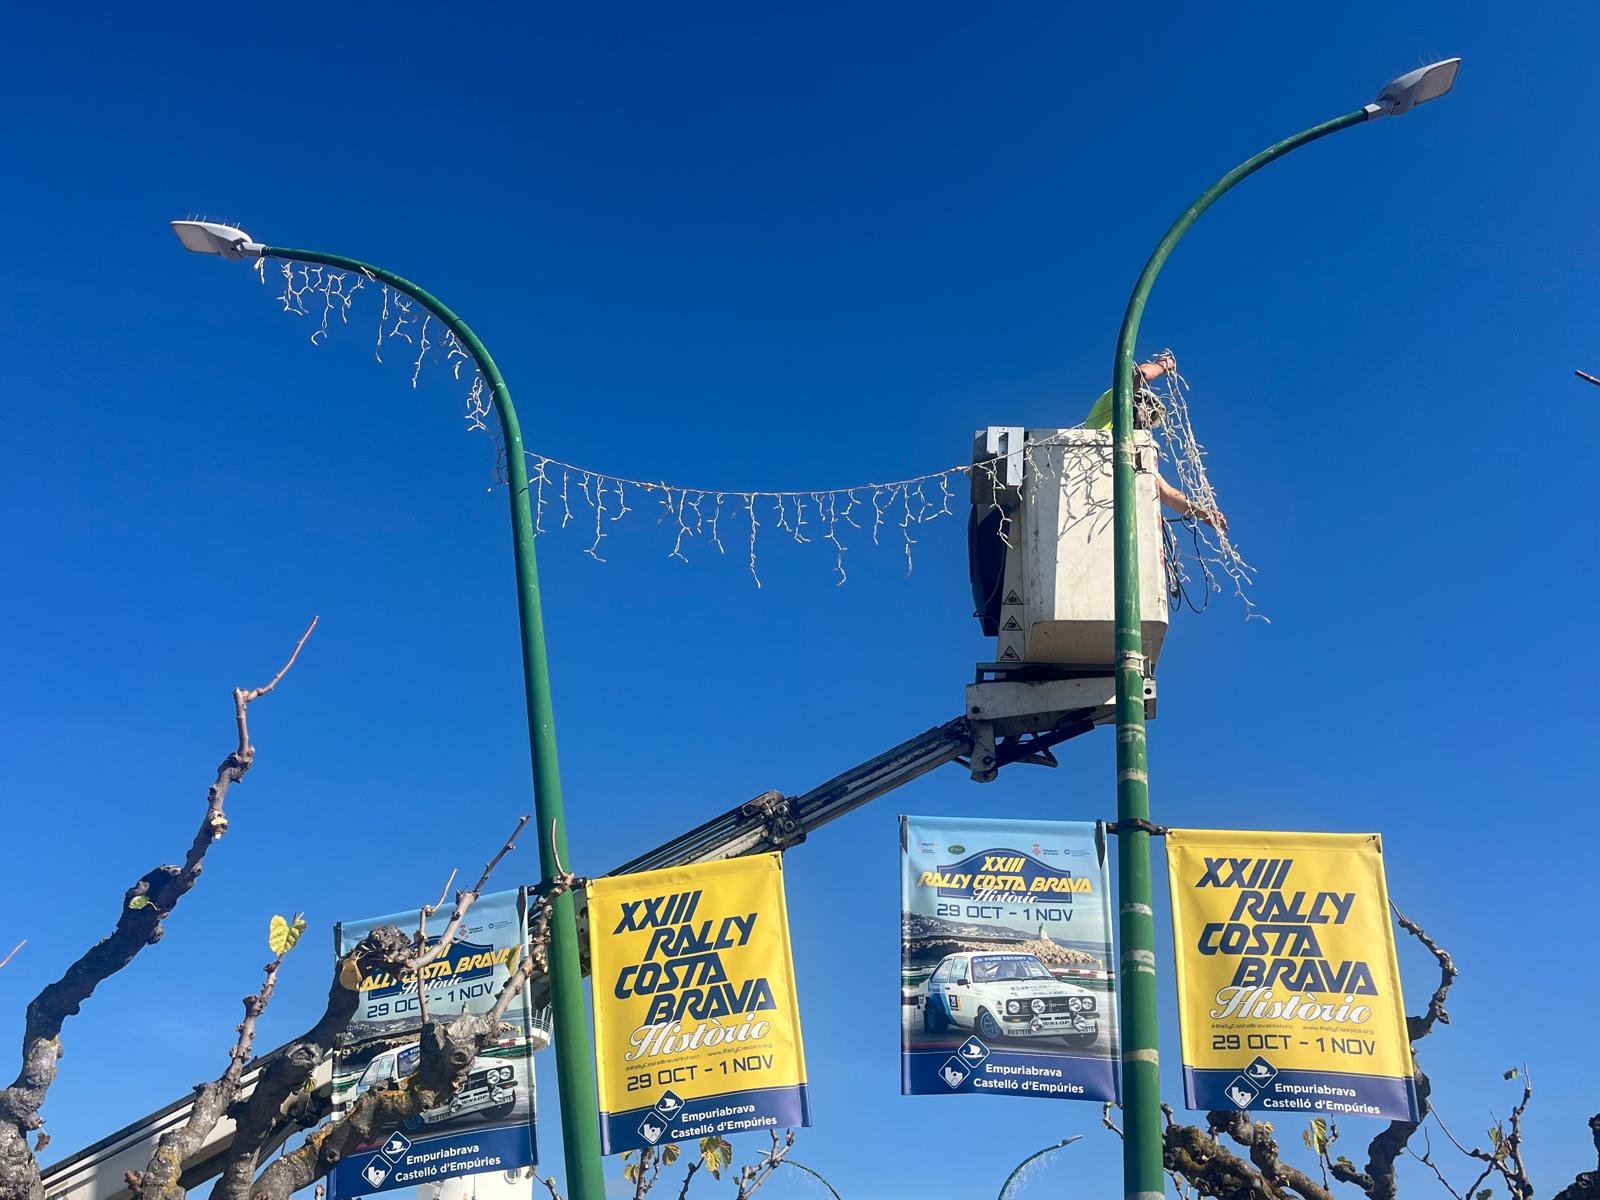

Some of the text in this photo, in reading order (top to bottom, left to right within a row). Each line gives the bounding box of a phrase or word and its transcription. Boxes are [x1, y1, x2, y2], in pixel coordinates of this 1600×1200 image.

[981, 856, 1026, 873] XXIII
[1195, 857, 1293, 890] XXIII
[918, 871, 1093, 893] RALLY COSTA BRAVA
[970, 887, 1038, 904] Històric
[1229, 890, 1356, 925] RALLY
[613, 890, 703, 935] XXIII
[937, 904, 961, 917] 29
[967, 906, 1003, 920] OCT
[1023, 908, 1030, 921] 1
[1036, 908, 1074, 922] NOV
[644, 912, 758, 961] RALLY
[1197, 922, 1323, 958] COSTA
[399, 973, 463, 996] Hstòric
[614, 951, 728, 1000] COSTA
[1231, 957, 1379, 995] BRAVA
[367, 1004, 389, 1019] 29
[447, 990, 455, 1002] 1
[460, 981, 494, 1001] NOV
[644, 977, 777, 1027] BRAVA
[1209, 985, 1372, 1024] Històric
[624, 1012, 772, 1062] Històric
[1212, 1034, 1241, 1050] 29
[1247, 1034, 1292, 1050] OCT
[1316, 1037, 1325, 1052] 1
[1331, 1038, 1376, 1056] NOV
[627, 1072, 652, 1092] 29
[658, 1065, 698, 1086] OCT
[719, 1060, 728, 1075] 1
[733, 1054, 775, 1072] NOV
[986, 1063, 1062, 1078] Empuriabrava
[973, 1077, 1084, 1094] Castelló d'Empúries
[1275, 1083, 1356, 1098] Empuriabrava
[681, 1103, 756, 1124] Empuriabrava
[1263, 1098, 1380, 1115] Castelló d'Empúries
[671, 1115, 778, 1139] Castelló d'Empúries
[406, 1144, 480, 1165] Empuriabrava
[395, 1156, 501, 1182] Castelló d'Empúries
